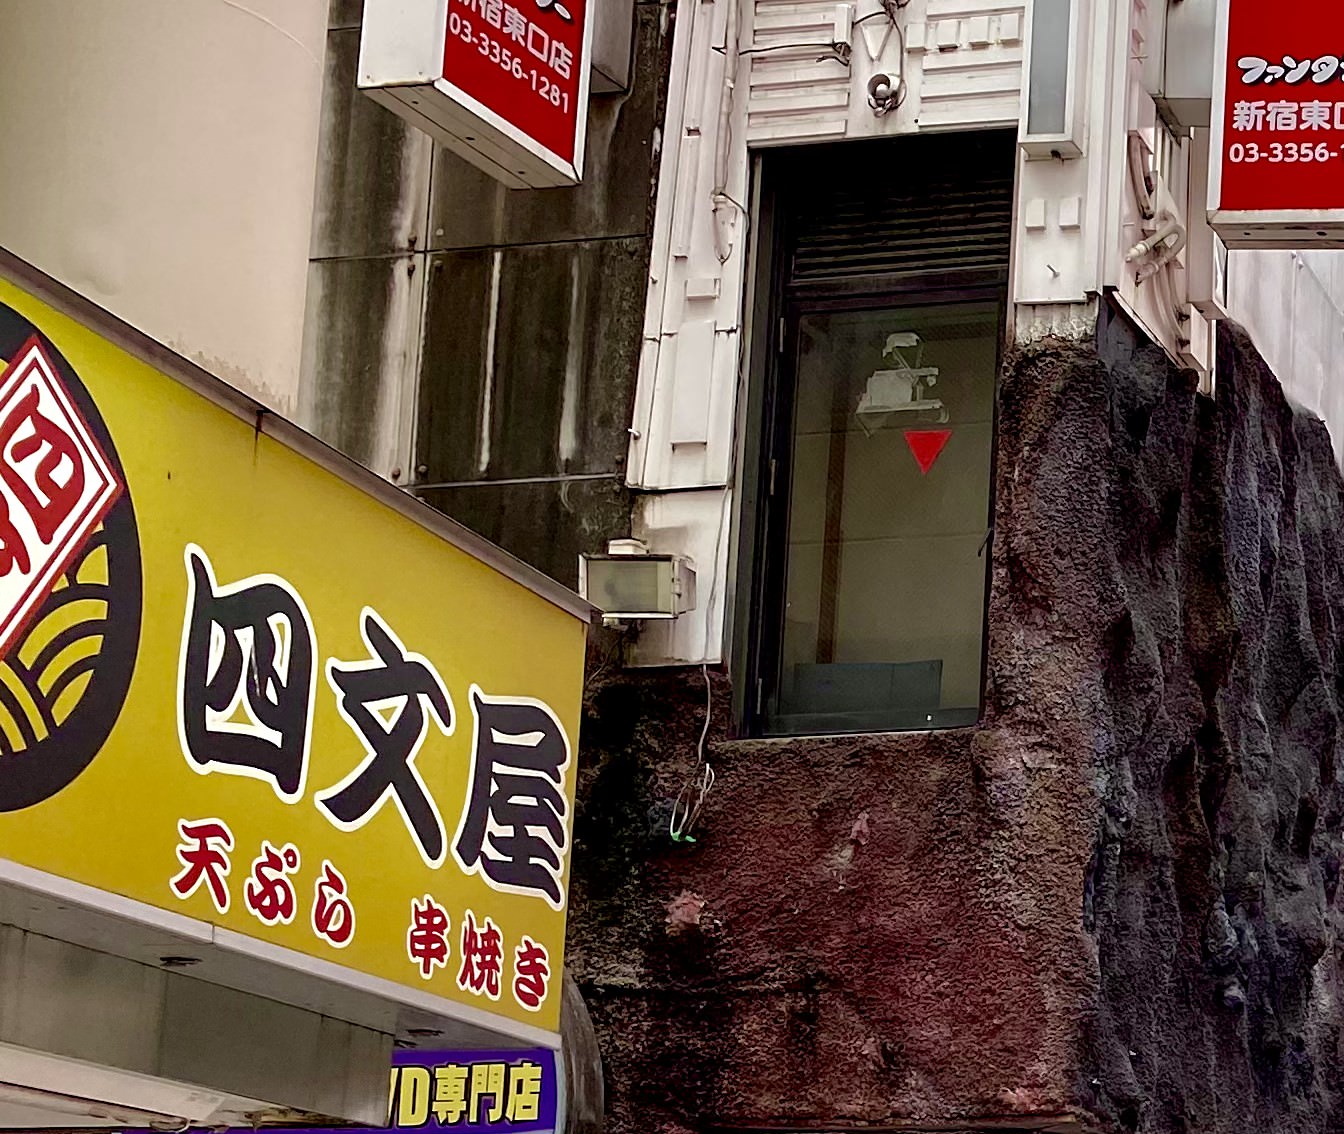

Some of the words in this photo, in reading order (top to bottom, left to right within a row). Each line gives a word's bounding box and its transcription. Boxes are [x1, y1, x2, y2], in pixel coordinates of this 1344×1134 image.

[449, 12, 569, 114] 03-3356-1281
[178, 543, 570, 910] 四文屋
[170, 817, 357, 946] 天ぷら
[407, 893, 550, 1012] 串焼き
